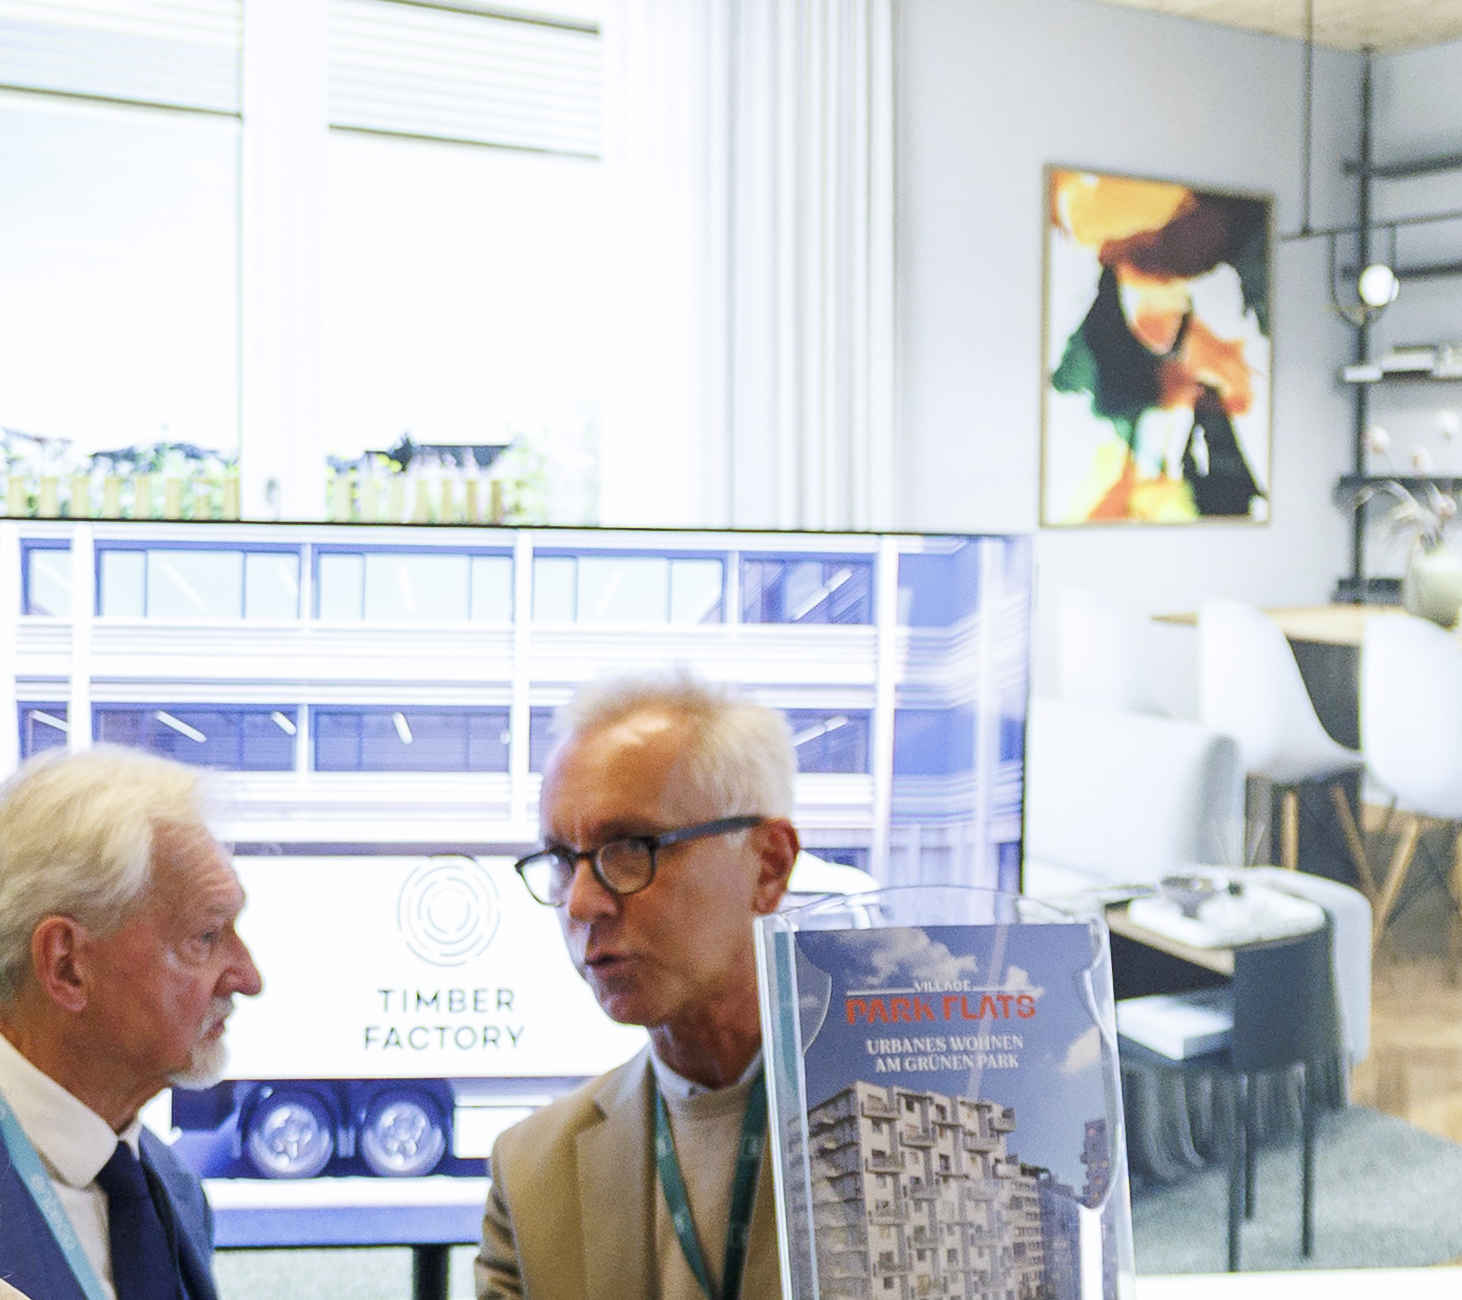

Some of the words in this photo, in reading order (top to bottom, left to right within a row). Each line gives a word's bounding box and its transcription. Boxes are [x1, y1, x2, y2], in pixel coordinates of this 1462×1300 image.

[377, 988, 515, 1013] TIMBER
[845, 996, 935, 1025] PARK
[943, 993, 1037, 1021] FLATS
[364, 1025, 524, 1051] FACTORY
[866, 1036, 947, 1054] URBANES
[948, 1034, 1025, 1052] WOHNEN
[874, 1058, 902, 1073] AM
[905, 1053, 975, 1072] GRÜNEN
[977, 1053, 1020, 1070] PARK
